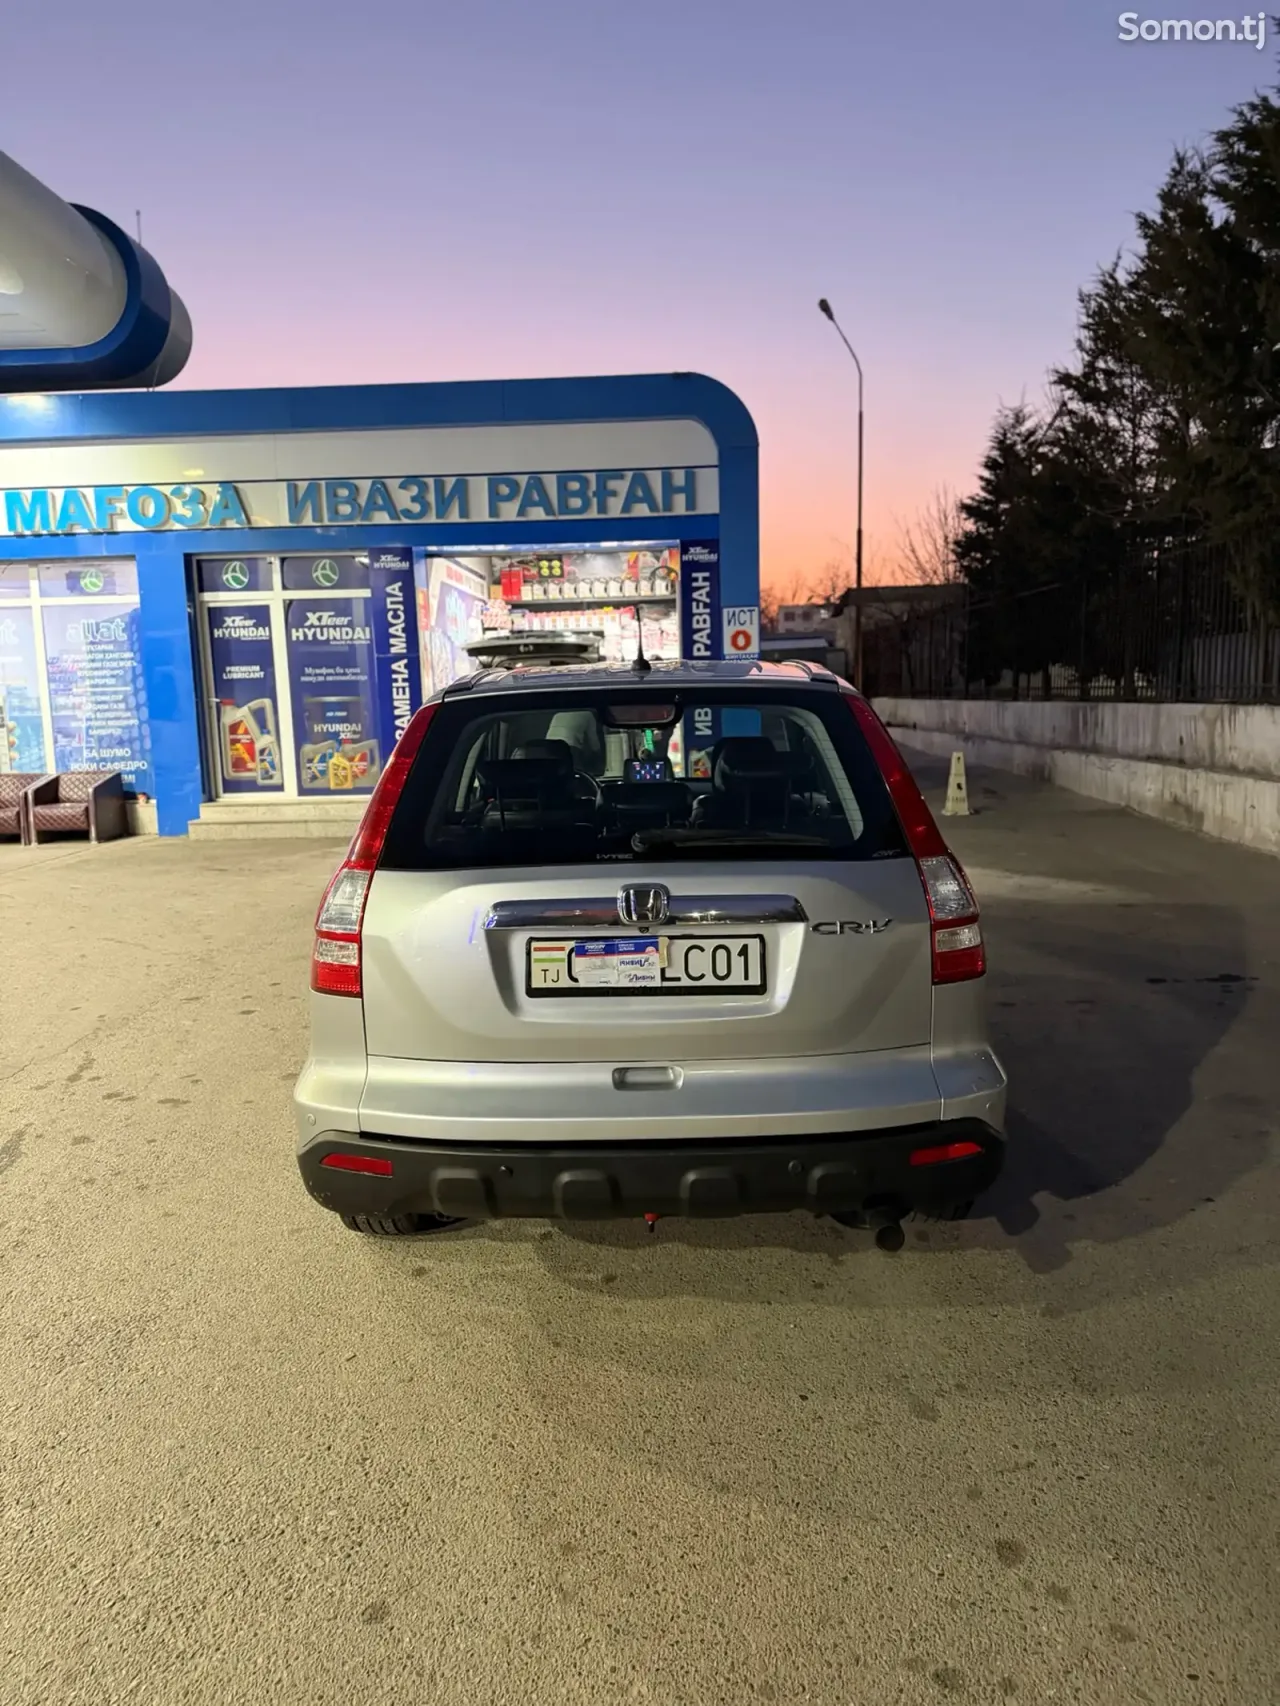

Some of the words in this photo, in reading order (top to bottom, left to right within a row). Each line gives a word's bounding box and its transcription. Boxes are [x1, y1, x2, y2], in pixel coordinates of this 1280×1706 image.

[286, 477, 470, 524] ИВАЗИ
[304, 611, 352, 626] XTeer
[386, 581, 407, 654] МАСЛА
[727, 608, 755, 626] ИСТ
[214, 627, 270, 638] HYUNDAI
[291, 627, 371, 641] HYUNDAI
[222, 671, 265, 680] LUBRICANT
[313, 723, 362, 733] HYUNDAI
[809, 918, 893, 935] CR-V
[540, 968, 560, 984] TJ
